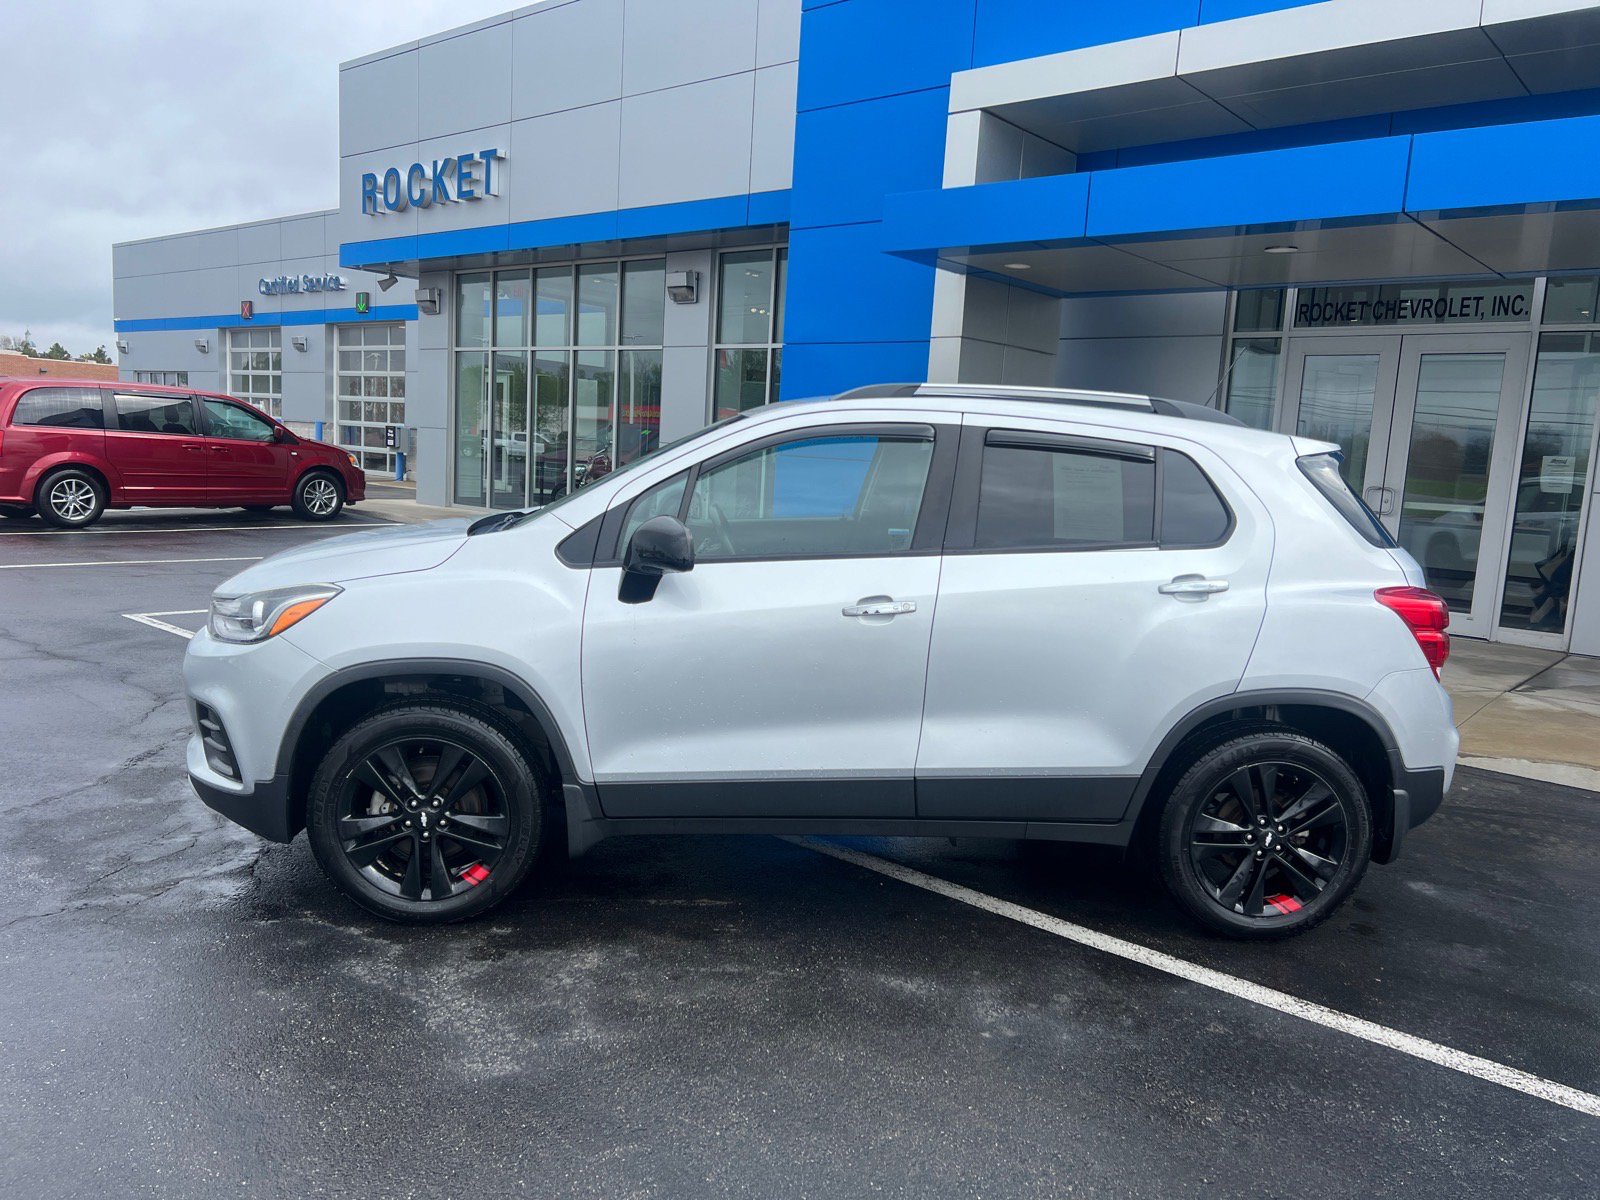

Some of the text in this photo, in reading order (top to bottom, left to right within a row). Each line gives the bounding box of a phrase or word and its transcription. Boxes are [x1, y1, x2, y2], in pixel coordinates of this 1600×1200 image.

[362, 148, 502, 215] ROCKET
[258, 273, 342, 296] Certified Service
[1298, 294, 1530, 323] ROCKET CHEVROLET, INC.
[512, 814, 532, 867] KELLY
